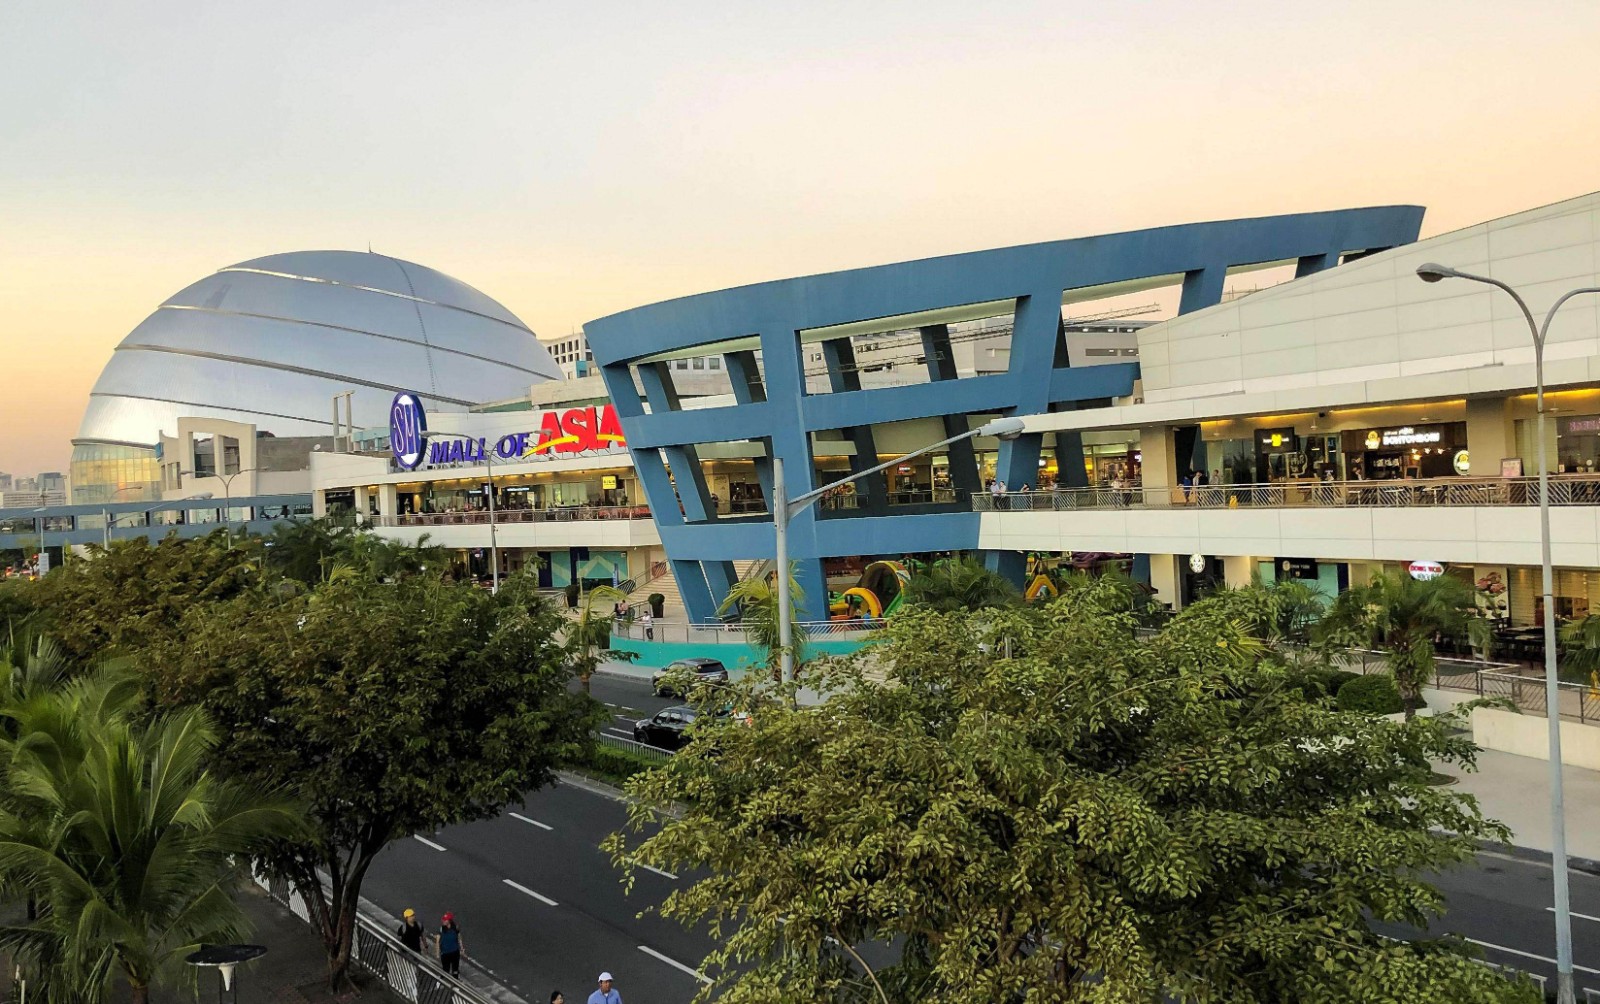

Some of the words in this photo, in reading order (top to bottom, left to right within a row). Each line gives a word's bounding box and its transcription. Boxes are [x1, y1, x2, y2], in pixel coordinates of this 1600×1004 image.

[429, 437, 488, 464] MALL
[497, 433, 530, 458] OF
[536, 404, 628, 455] ASIA
